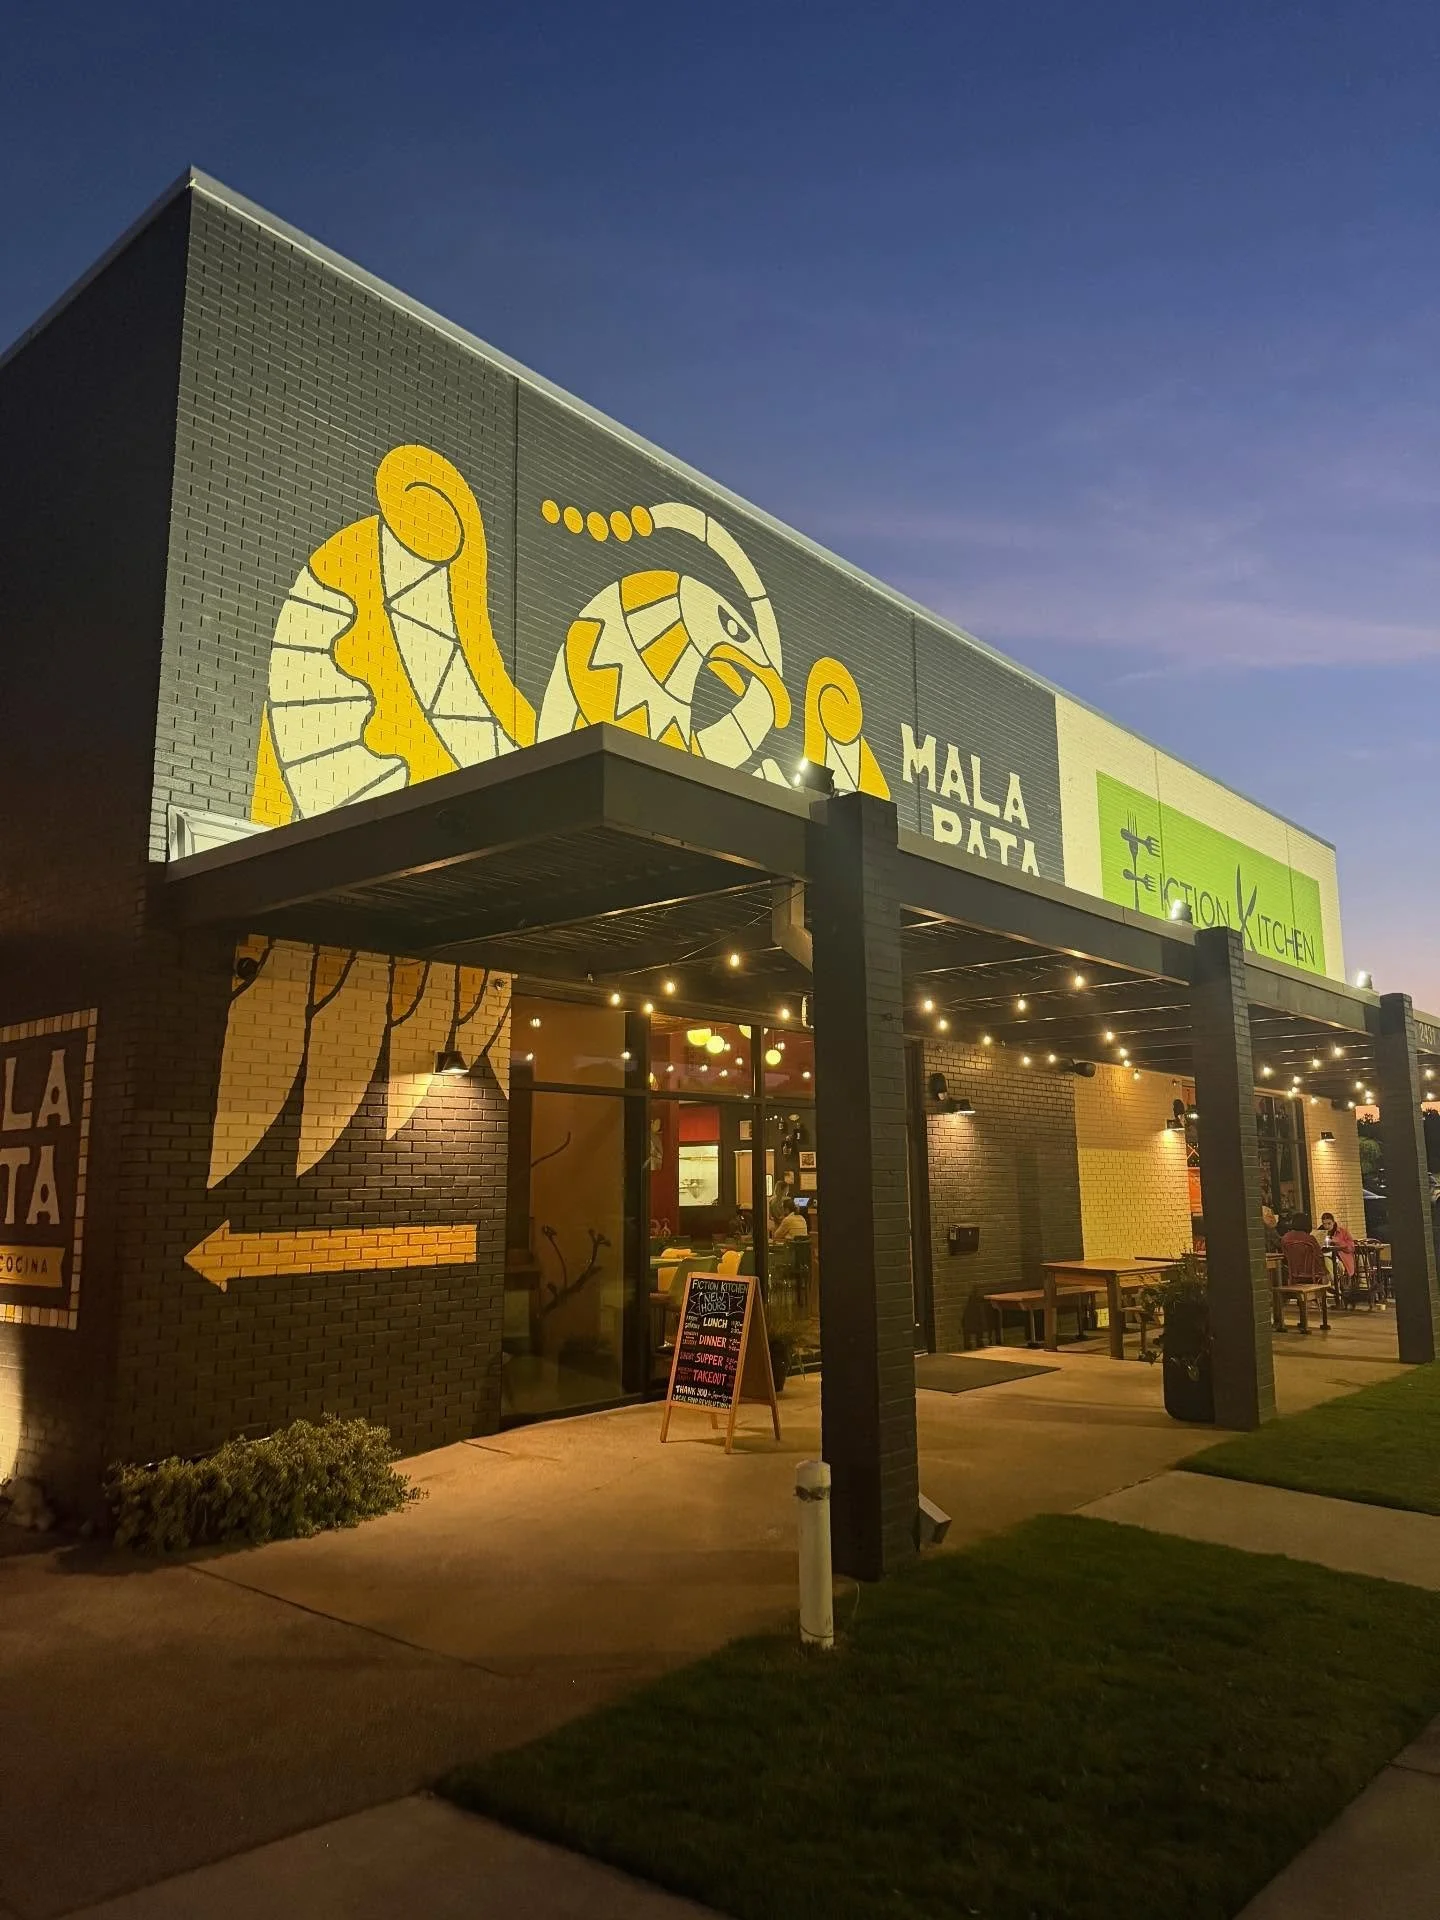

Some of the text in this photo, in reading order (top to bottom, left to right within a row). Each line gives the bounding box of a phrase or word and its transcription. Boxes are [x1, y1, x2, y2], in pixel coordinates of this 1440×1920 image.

[901, 722, 1030, 830] MALA
[931, 804, 1040, 878] PATA
[1236, 863, 1316, 965] KITCHEN
[692, 1279, 748, 1294] FICTION KITCHEN
[703, 1292, 725, 1303] NEW
[701, 1301, 727, 1313] HOURS
[703, 1317, 728, 1329] LUNCH
[699, 1334, 727, 1349] DINNER
[694, 1352, 724, 1367] SUPPER
[693, 1369, 727, 1386] TAKEOUT
[675, 1384, 696, 1396] THANK
